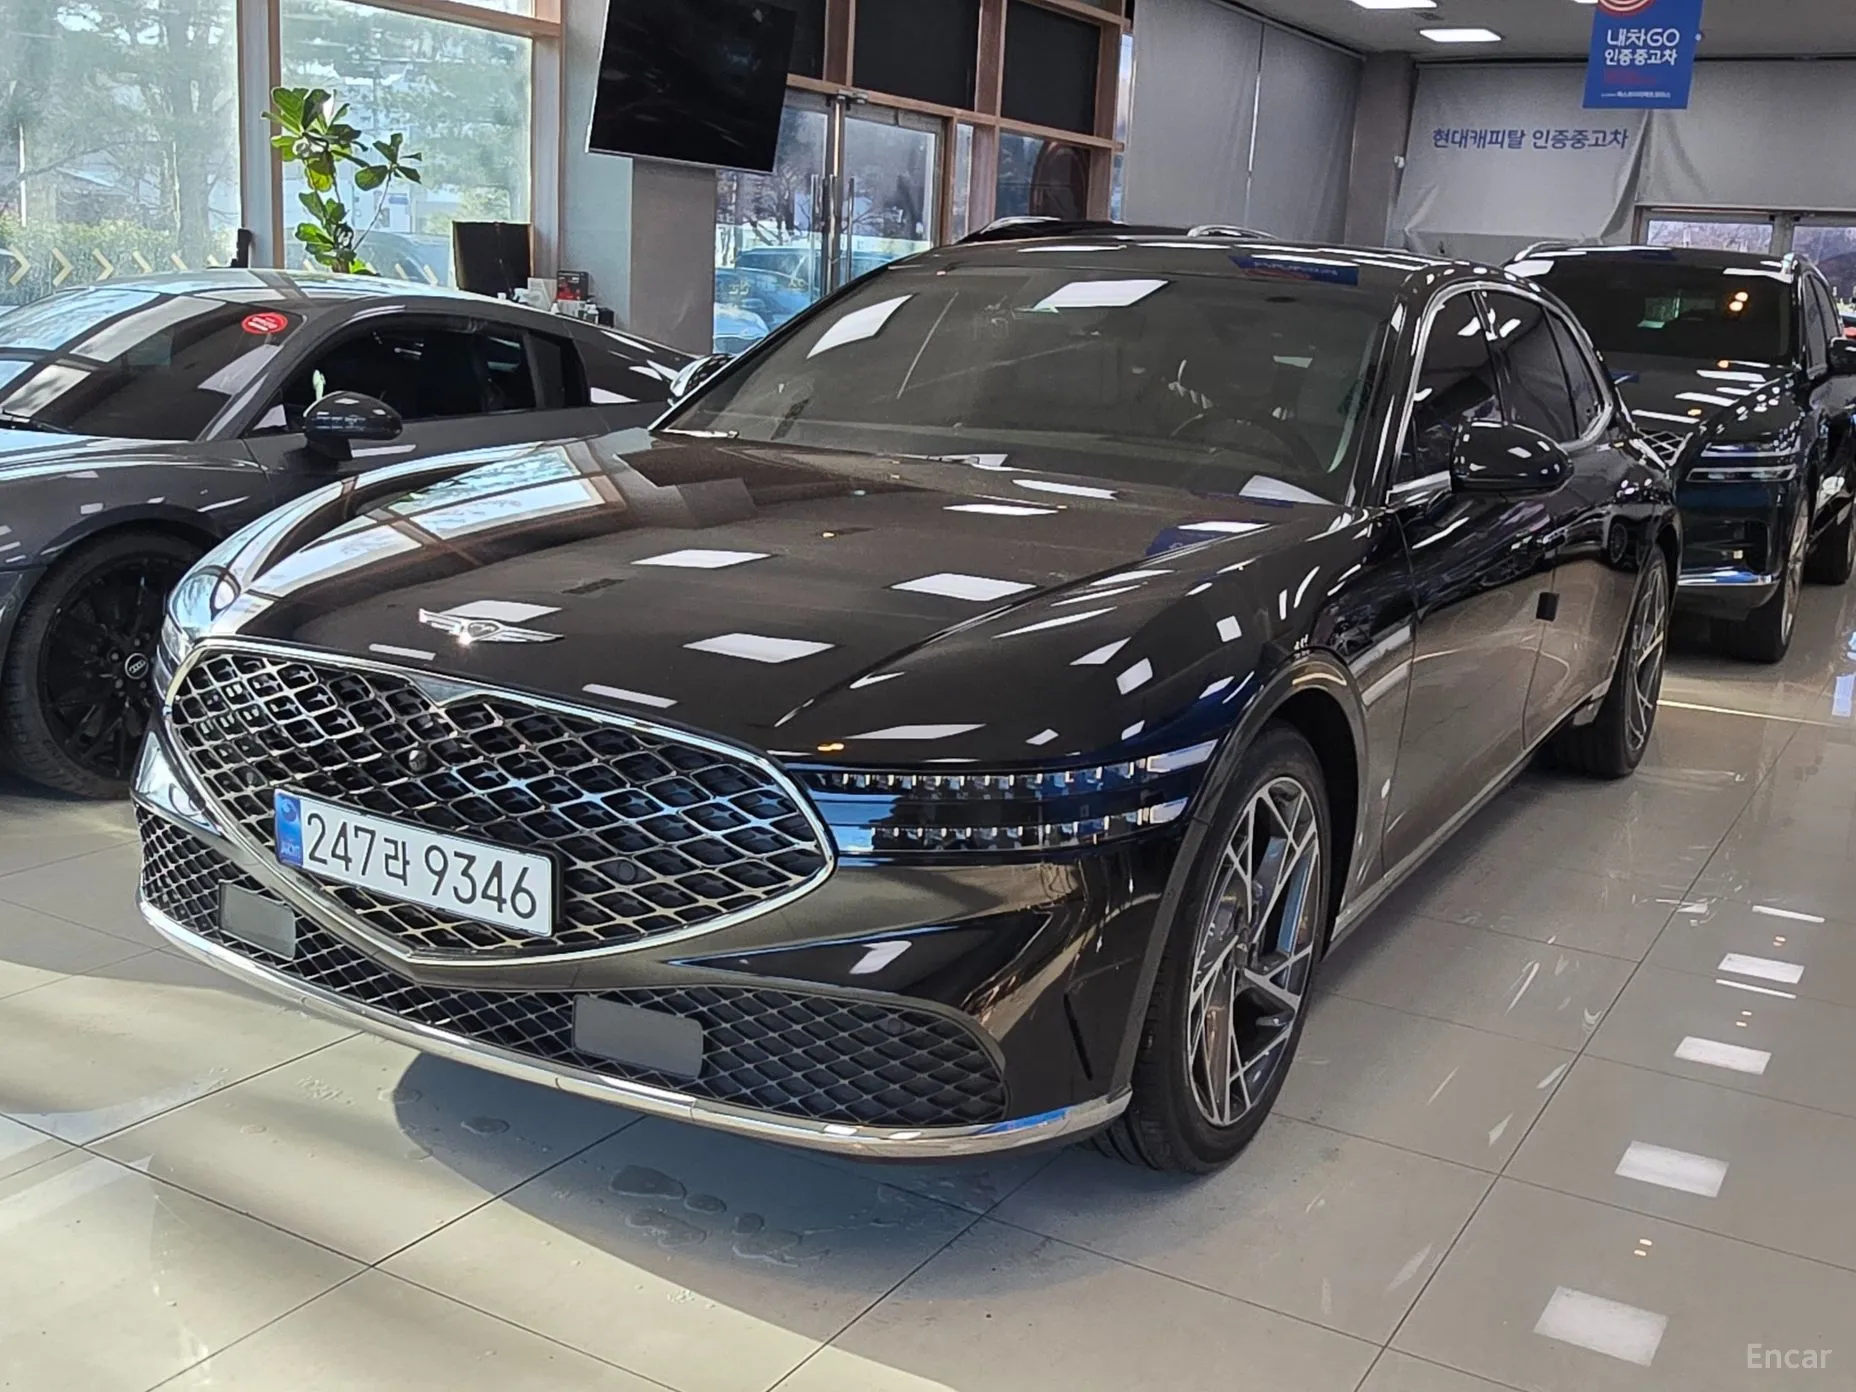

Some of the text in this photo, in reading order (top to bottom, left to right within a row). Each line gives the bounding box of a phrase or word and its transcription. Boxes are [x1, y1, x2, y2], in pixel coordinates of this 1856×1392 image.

[1606, 28, 1680, 47] 내차GO
[1604, 48, 1677, 66] 인증중고차
[1432, 128, 1628, 150] 현대캐피탈 인증중고차
[424, 844, 537, 919] 9346
